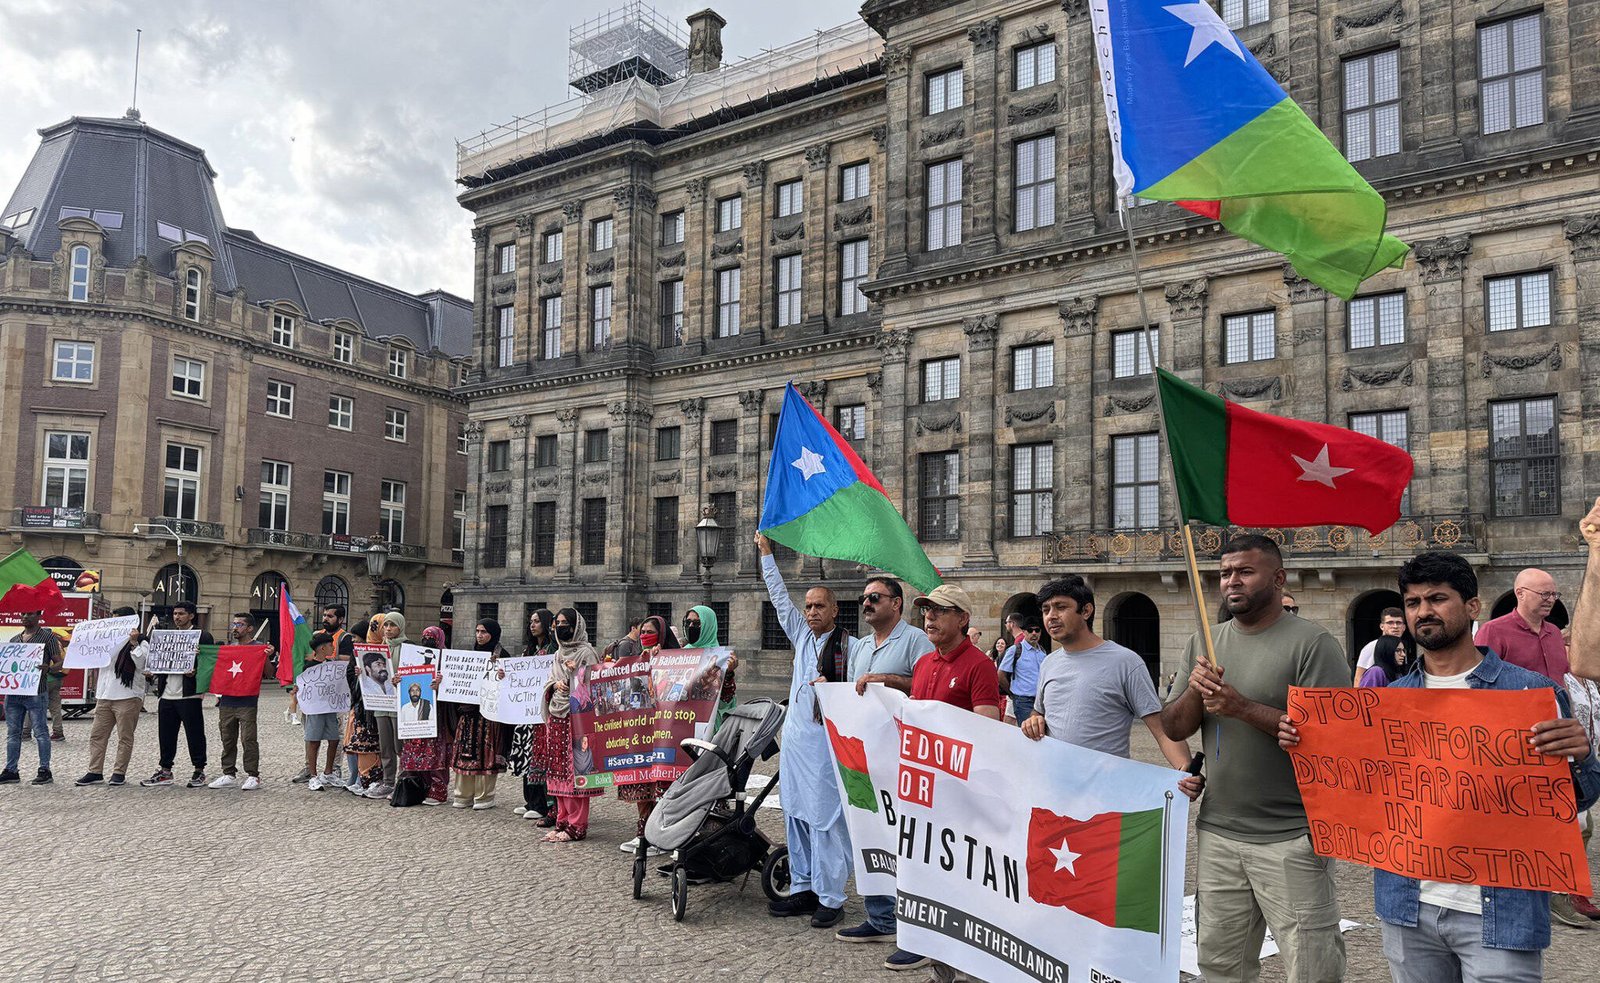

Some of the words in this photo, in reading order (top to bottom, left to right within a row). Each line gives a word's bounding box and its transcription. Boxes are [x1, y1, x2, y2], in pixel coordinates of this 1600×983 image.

[659, 654, 701, 666] Balochistan
[623, 714, 647, 727] world
[663, 709, 672, 719] to
[674, 710, 696, 724] stop
[1288, 688, 1380, 727] STOP
[631, 733, 640, 746] &
[1381, 718, 1563, 767] ENFORCE
[1291, 752, 1578, 823] DISAPPEARANCES
[1384, 801, 1423, 839] IN
[1312, 819, 1578, 892] BALOCHISTAN
[964, 918, 1064, 983] NETHERLANDS
